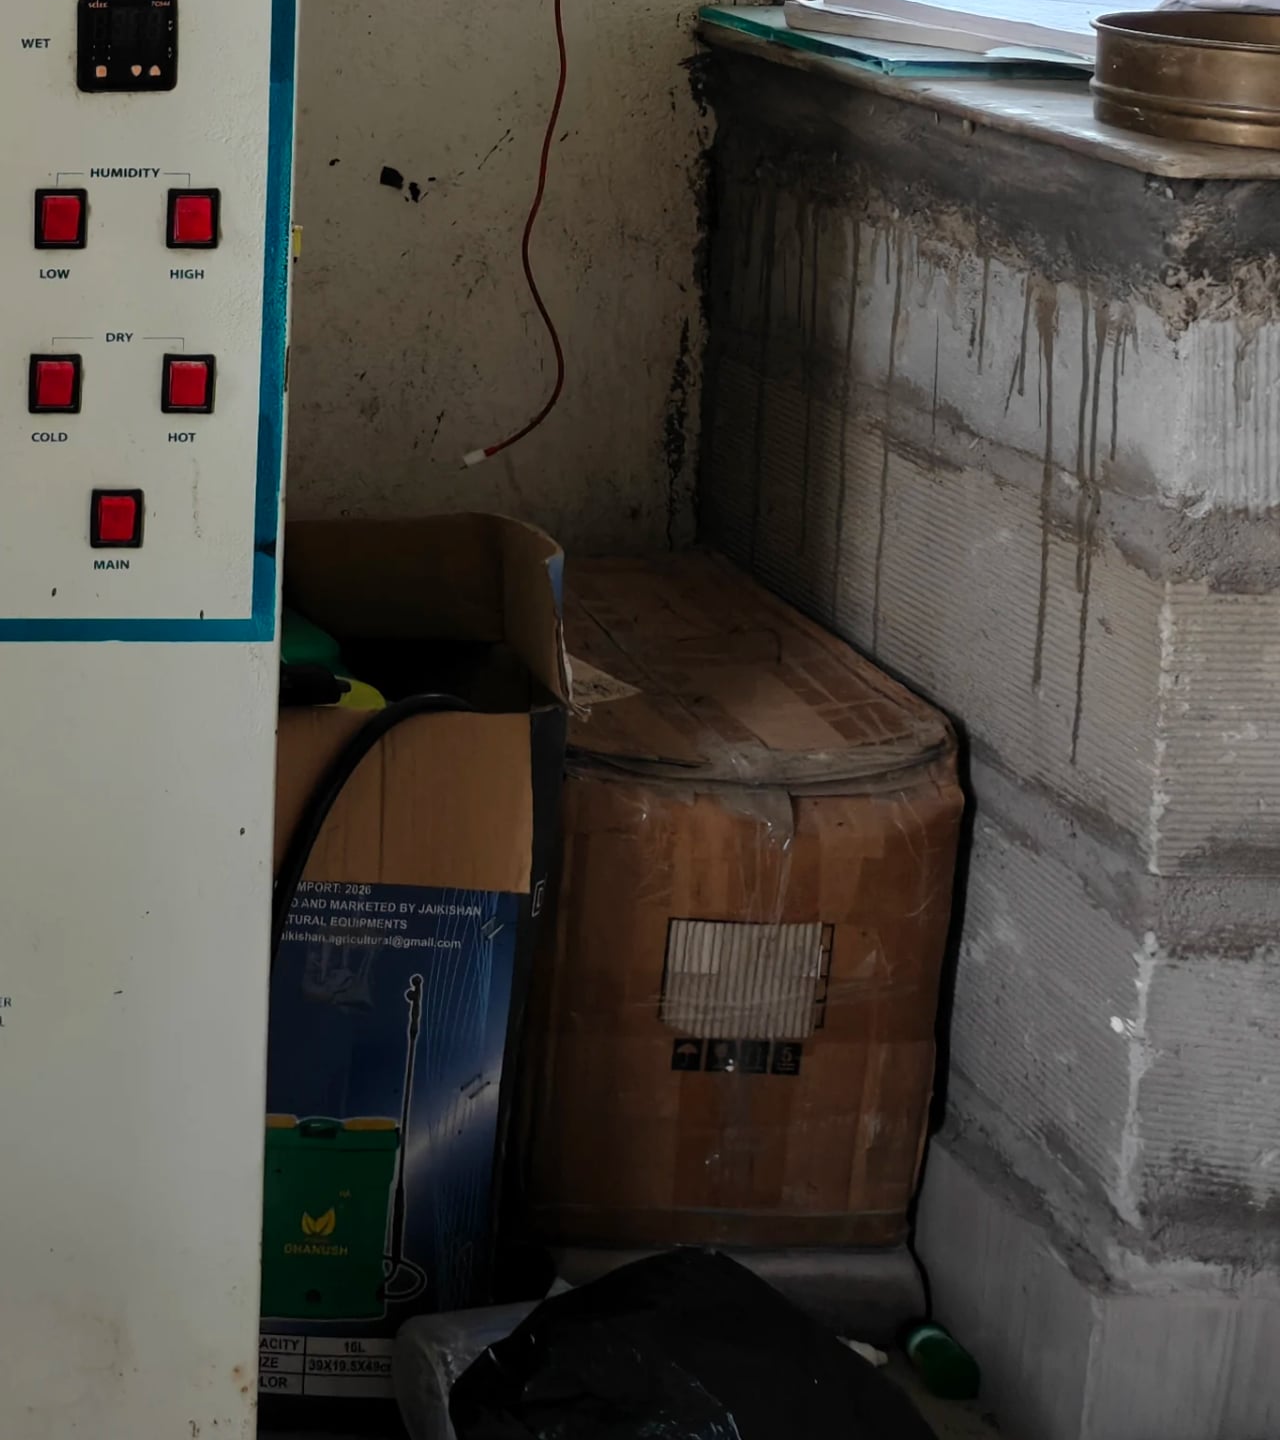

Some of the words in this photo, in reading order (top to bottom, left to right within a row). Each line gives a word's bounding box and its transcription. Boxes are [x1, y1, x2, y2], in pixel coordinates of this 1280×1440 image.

[21, 38, 51, 49] WET
[90, 167, 160, 178] HUMIDITY
[39, 268, 71, 280] LOW
[169, 268, 205, 280] HIGH
[105, 332, 134, 343] DRY
[31, 432, 68, 443] COLD
[168, 432, 196, 443] HOT
[93, 559, 130, 570] MAIN
[296, 880, 341, 894] MPORT:
[301, 898, 327, 909] AND
[330, 899, 396, 912] MARKETED
[399, 902, 416, 913] BY
[418, 904, 482, 916] JAIKISHAN
[285, 913, 327, 926] TURAL
[330, 916, 408, 929] EQUIPMENTS
[281, 930, 462, 949] ikishan.agricultural@gmail.com
[259, 1338, 299, 1351] ACITY
[259, 1356, 279, 1368] IZE
[259, 1376, 288, 1388] LOR
